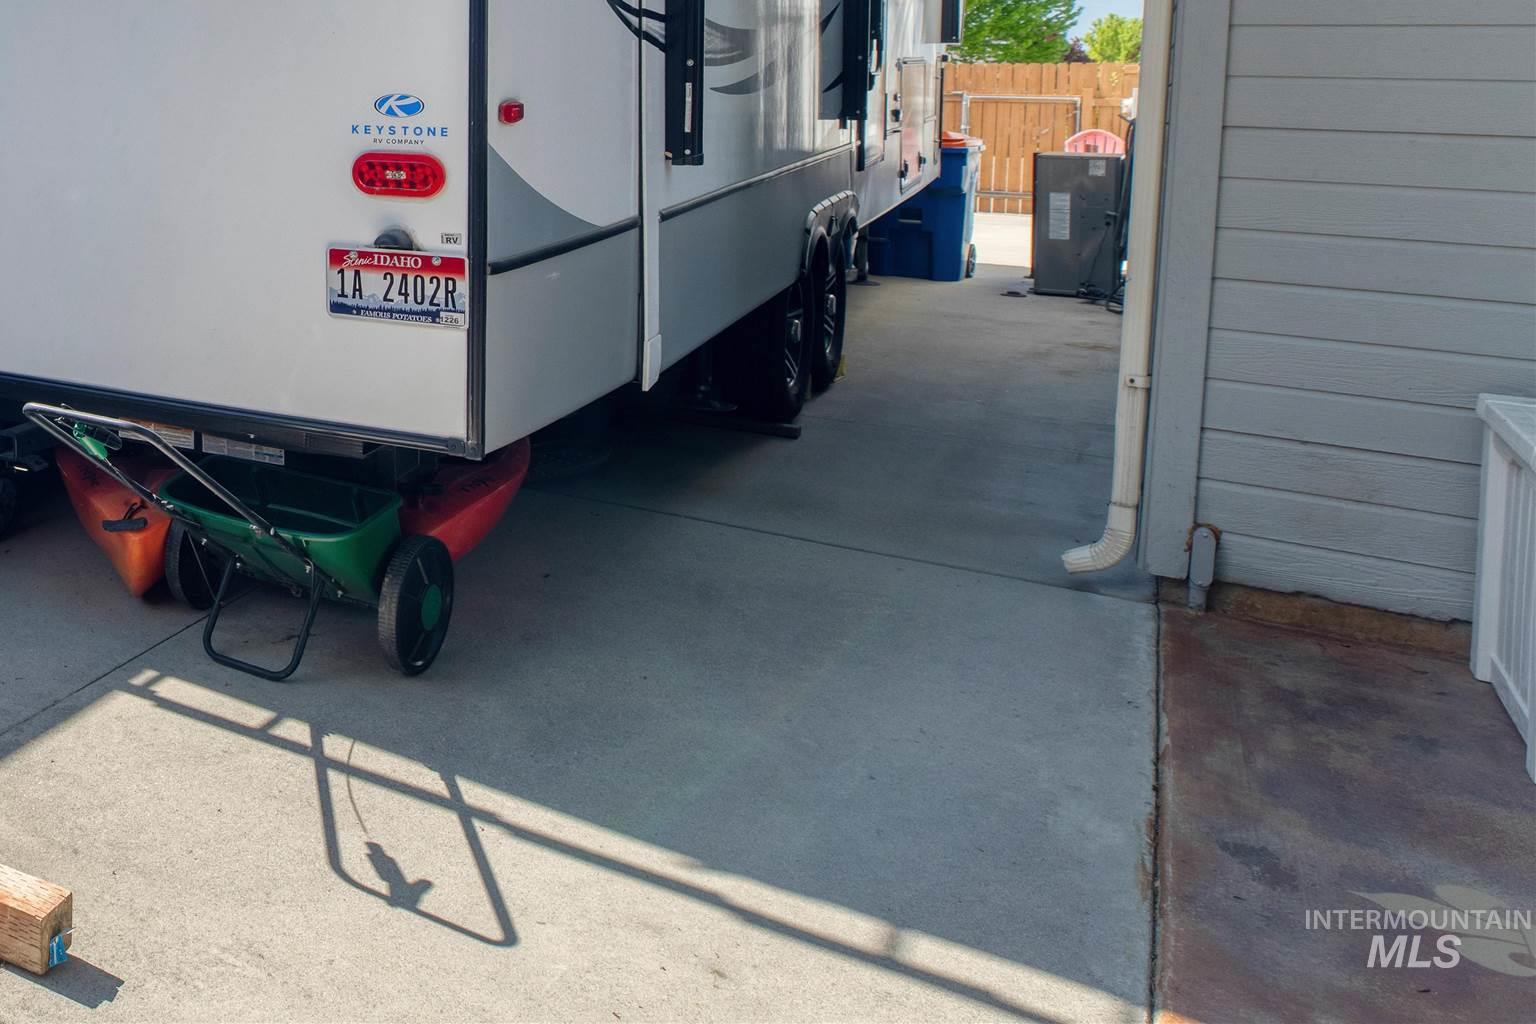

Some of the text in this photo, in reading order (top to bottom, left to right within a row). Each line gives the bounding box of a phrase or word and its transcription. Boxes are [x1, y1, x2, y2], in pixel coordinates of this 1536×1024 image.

[351, 124, 448, 137] KEYSTONE
[342, 254, 422, 269] Scenic IDAHO
[337, 268, 457, 309] 1A 2402R
[360, 309, 432, 323] FAMOUS POTATOES
